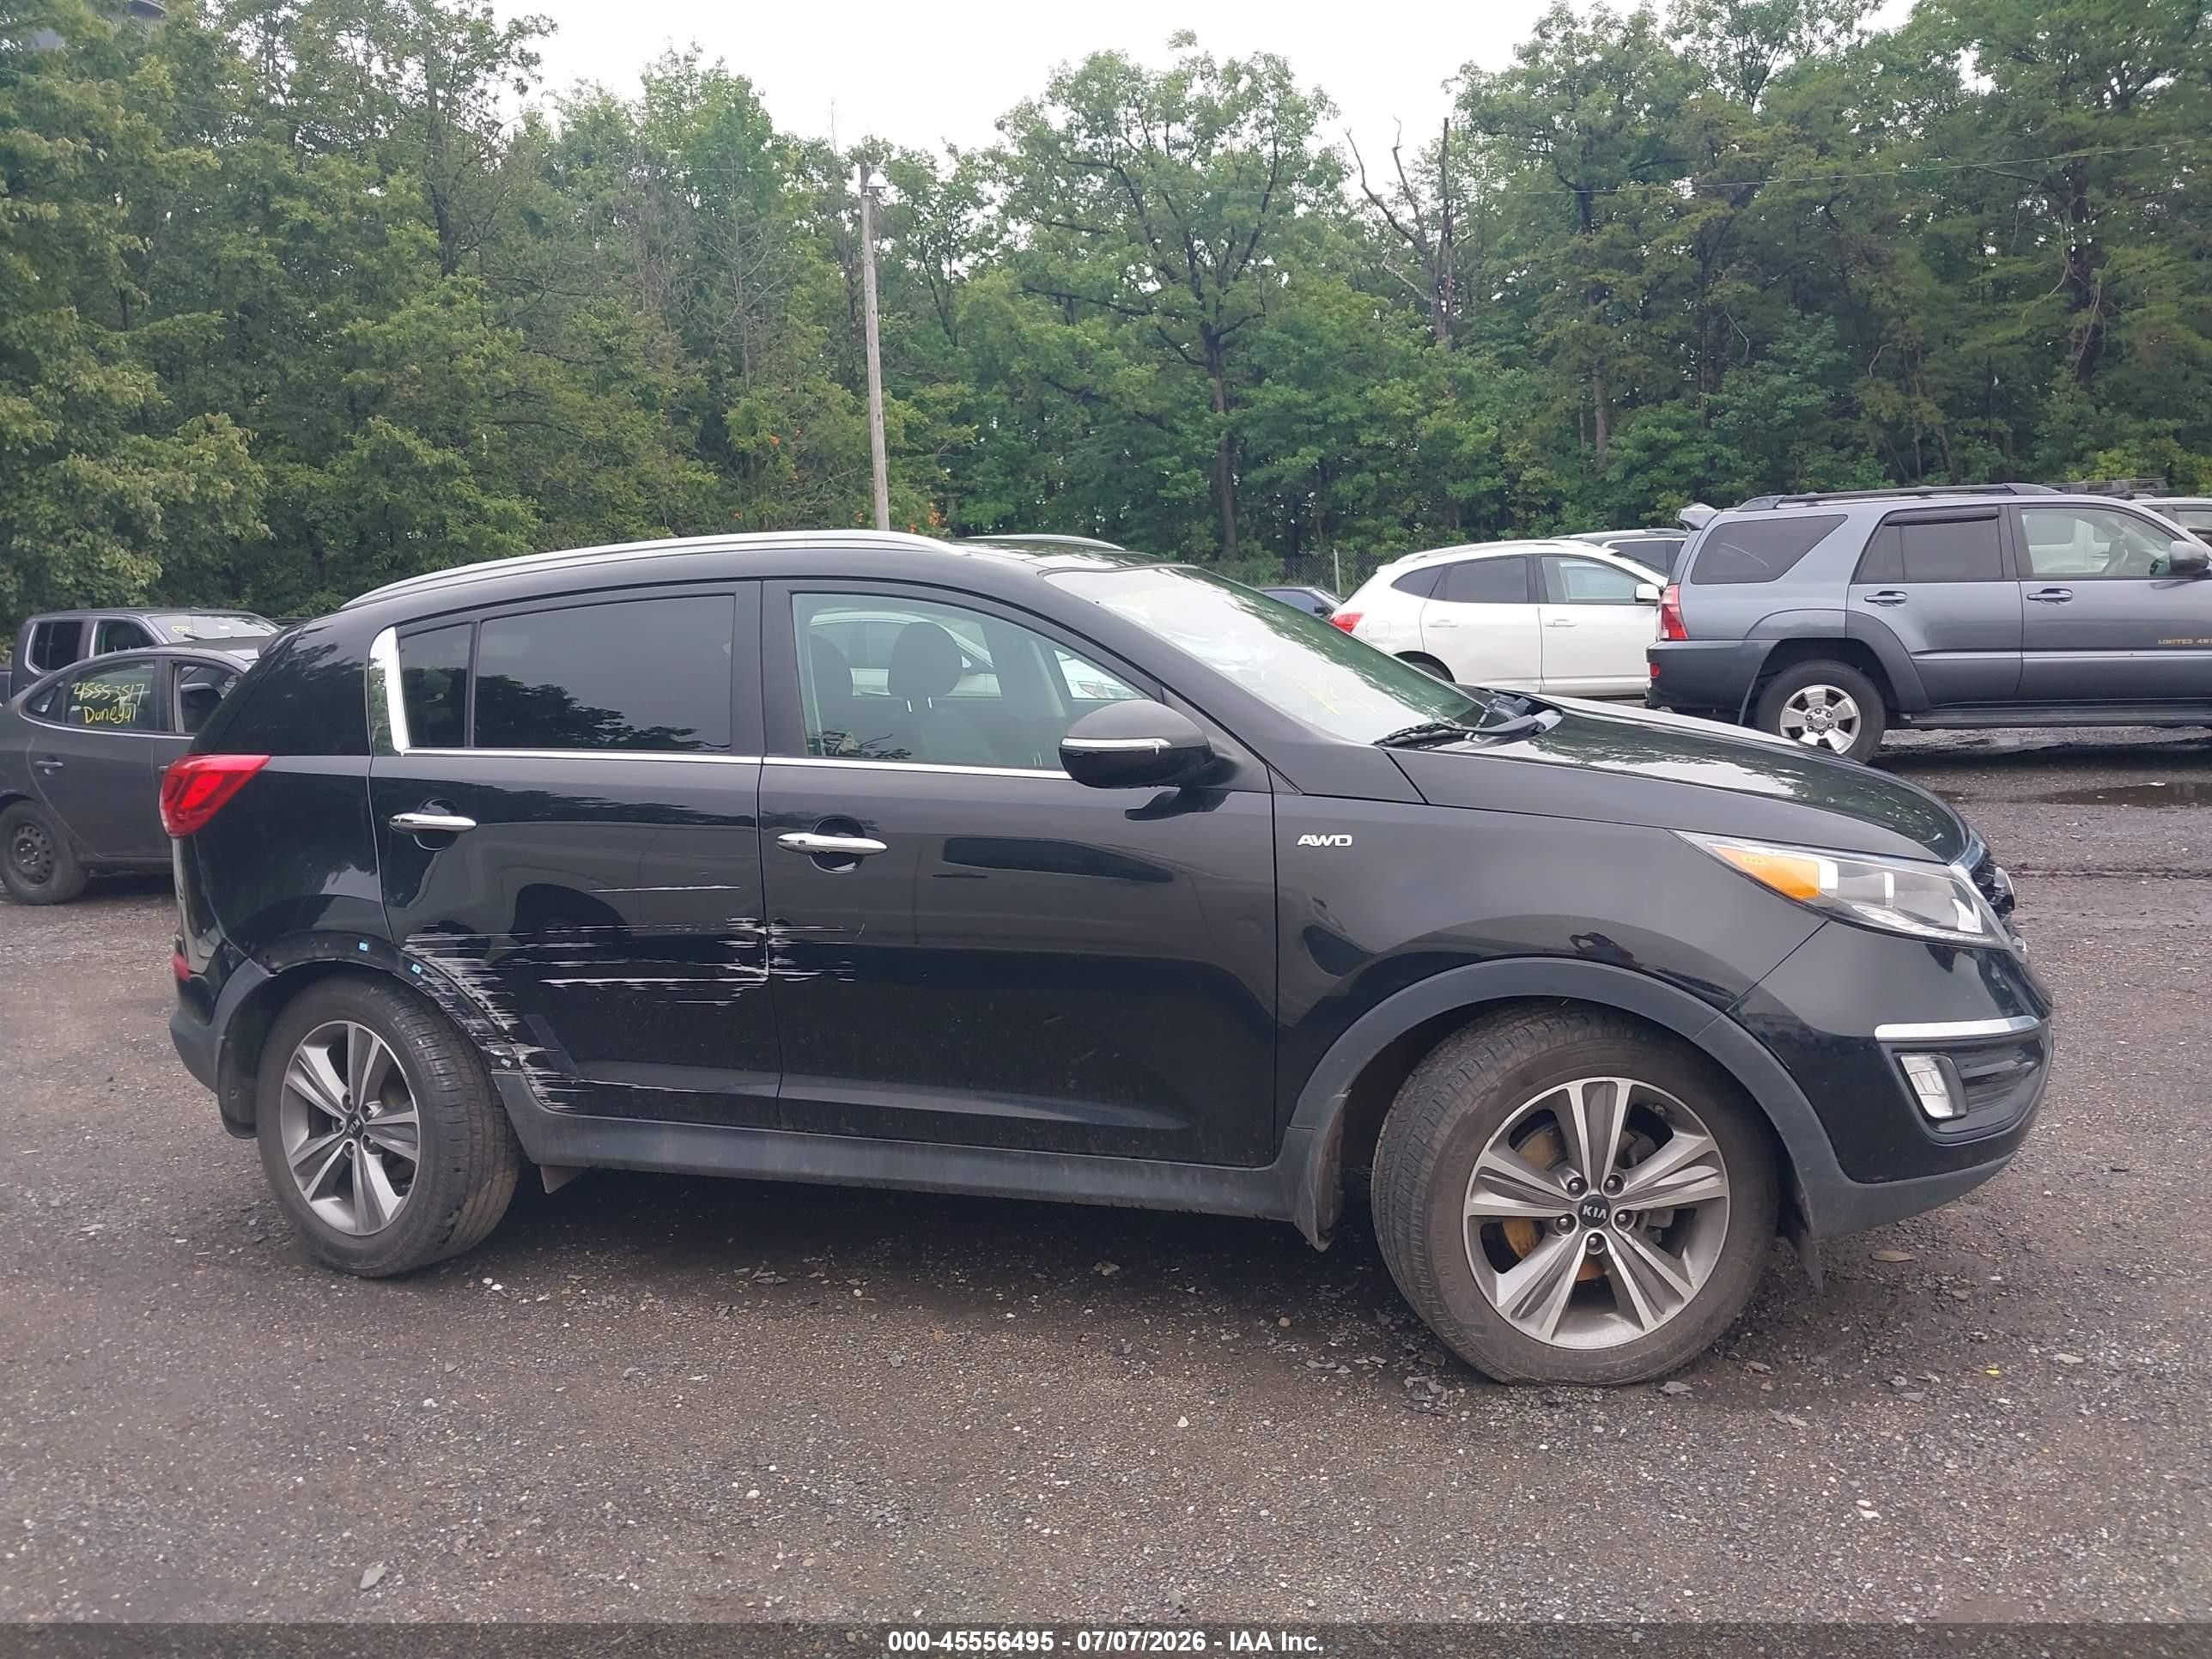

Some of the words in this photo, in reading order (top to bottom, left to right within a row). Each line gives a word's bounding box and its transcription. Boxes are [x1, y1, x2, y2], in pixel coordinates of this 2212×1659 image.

[73, 682, 145, 707] 45553517
[82, 702, 137, 725] Donegal
[1297, 834, 1352, 847] AWD
[1582, 1205, 1607, 1219] KIA
